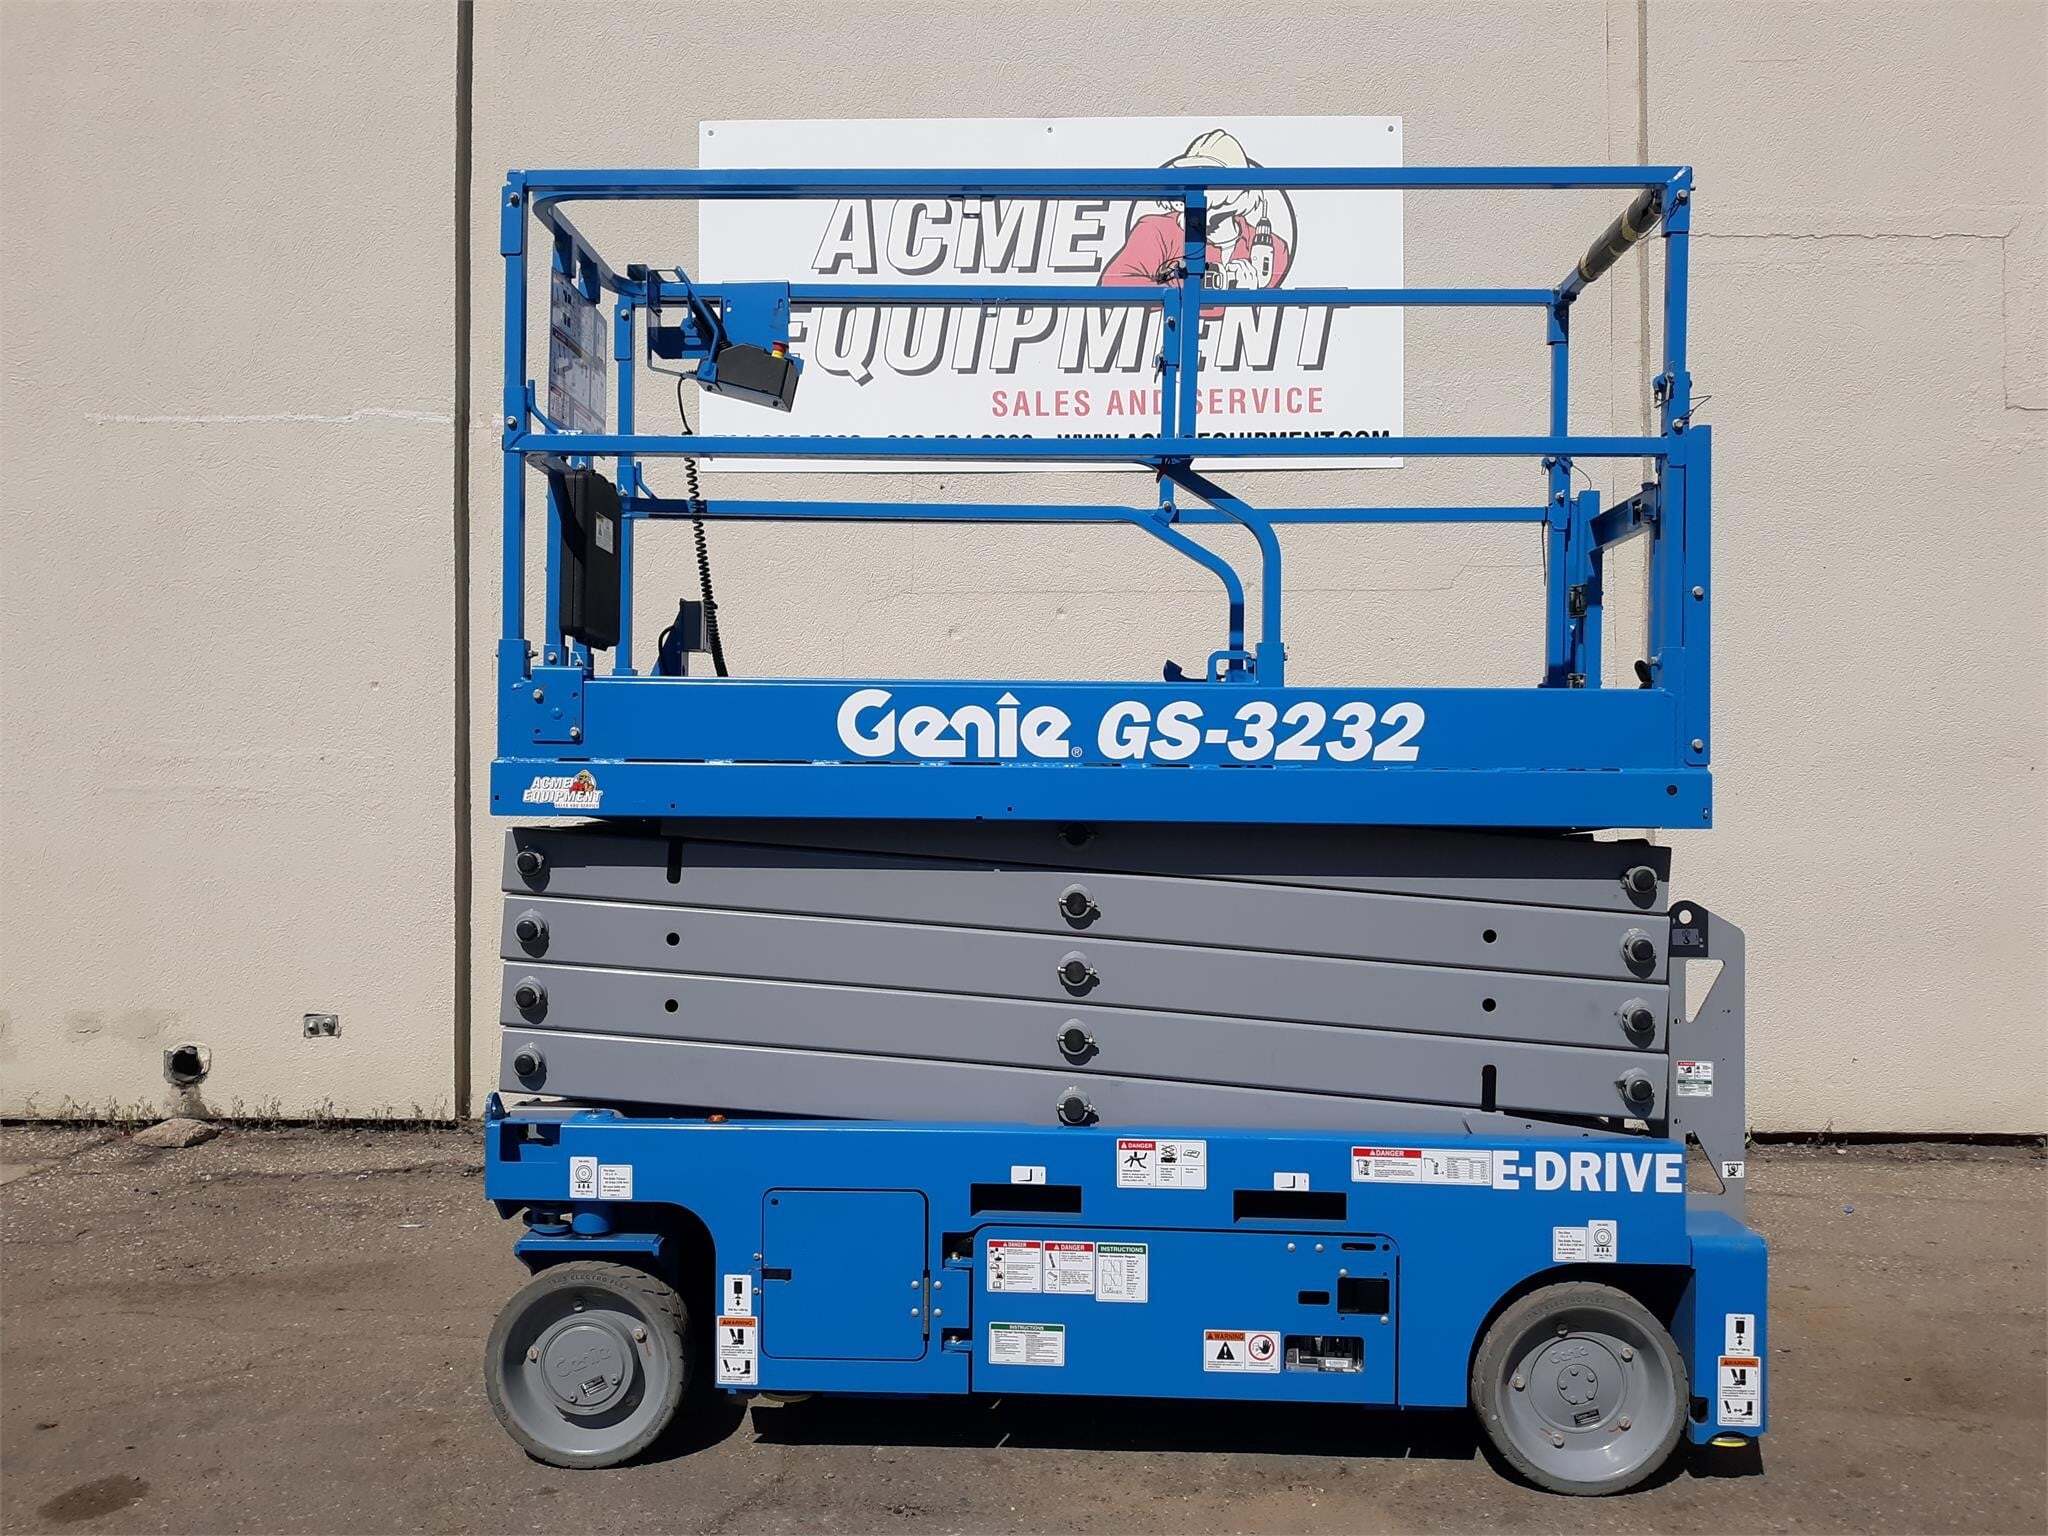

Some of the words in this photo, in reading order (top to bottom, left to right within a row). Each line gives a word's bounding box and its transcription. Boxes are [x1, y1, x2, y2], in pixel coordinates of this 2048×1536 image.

[811, 198, 1105, 276] ACME
[789, 304, 1349, 388] QUIPMNT
[991, 390, 1090, 418] SALES
[1098, 700, 1426, 763] GS-3232
[523, 790, 602, 803] EQUIPMENT
[530, 777, 573, 790] ACME
[1492, 1150, 1683, 1193] E-DRIVE
[1214, 1333, 1244, 1341] WARNING
